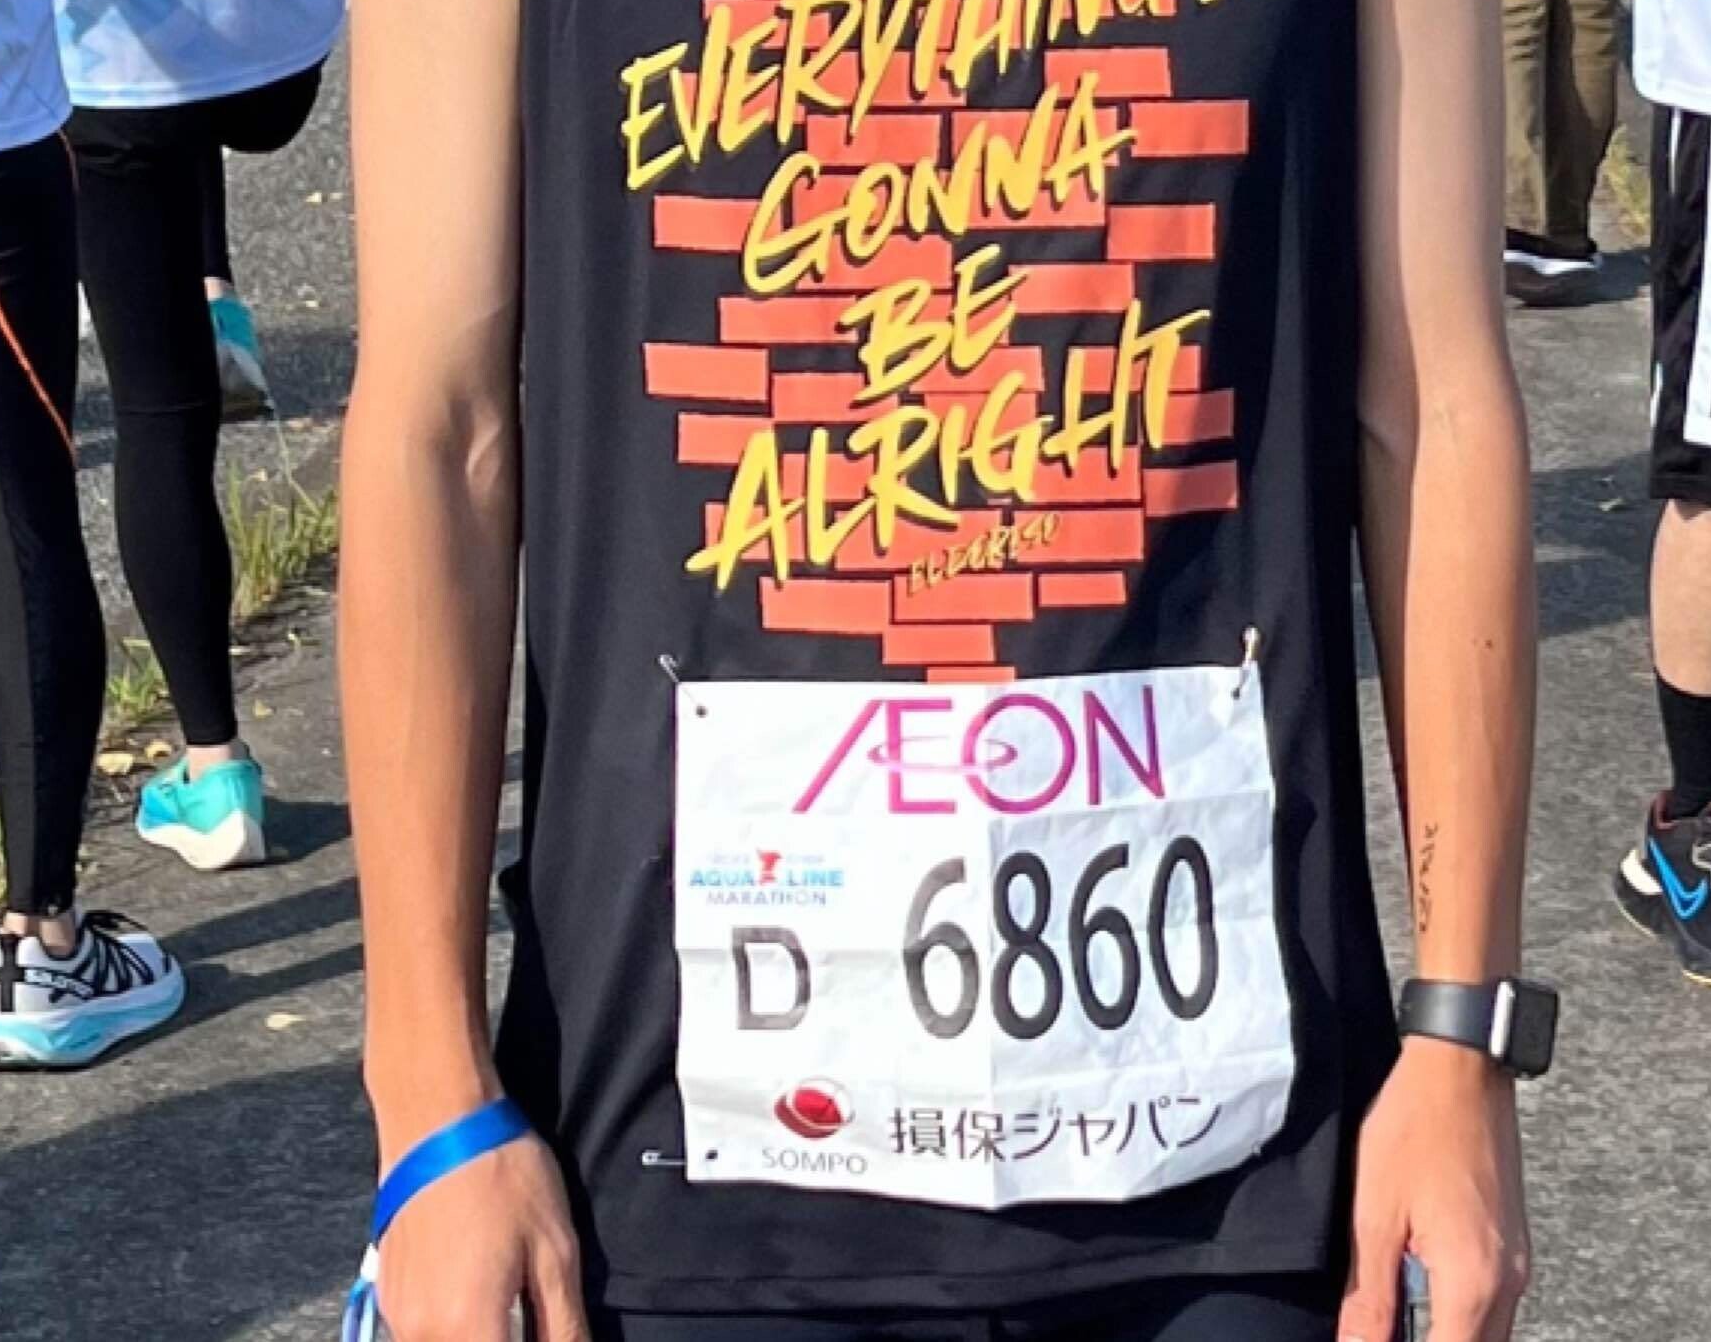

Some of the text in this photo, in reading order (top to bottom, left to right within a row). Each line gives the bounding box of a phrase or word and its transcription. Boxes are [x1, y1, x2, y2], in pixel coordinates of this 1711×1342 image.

[743, 72, 1138, 292] GONNA
[837, 244, 1029, 401] BE
[685, 299, 1211, 594] ALRIGHT
[689, 869, 844, 887] AQUA LINE
[706, 889, 827, 906] MARATHON
[731, 926, 811, 1030] D
[902, 835, 1219, 1040] 6860
[761, 1145, 868, 1176] SOMPO
[888, 1094, 1224, 1163] 損保ジャパン
